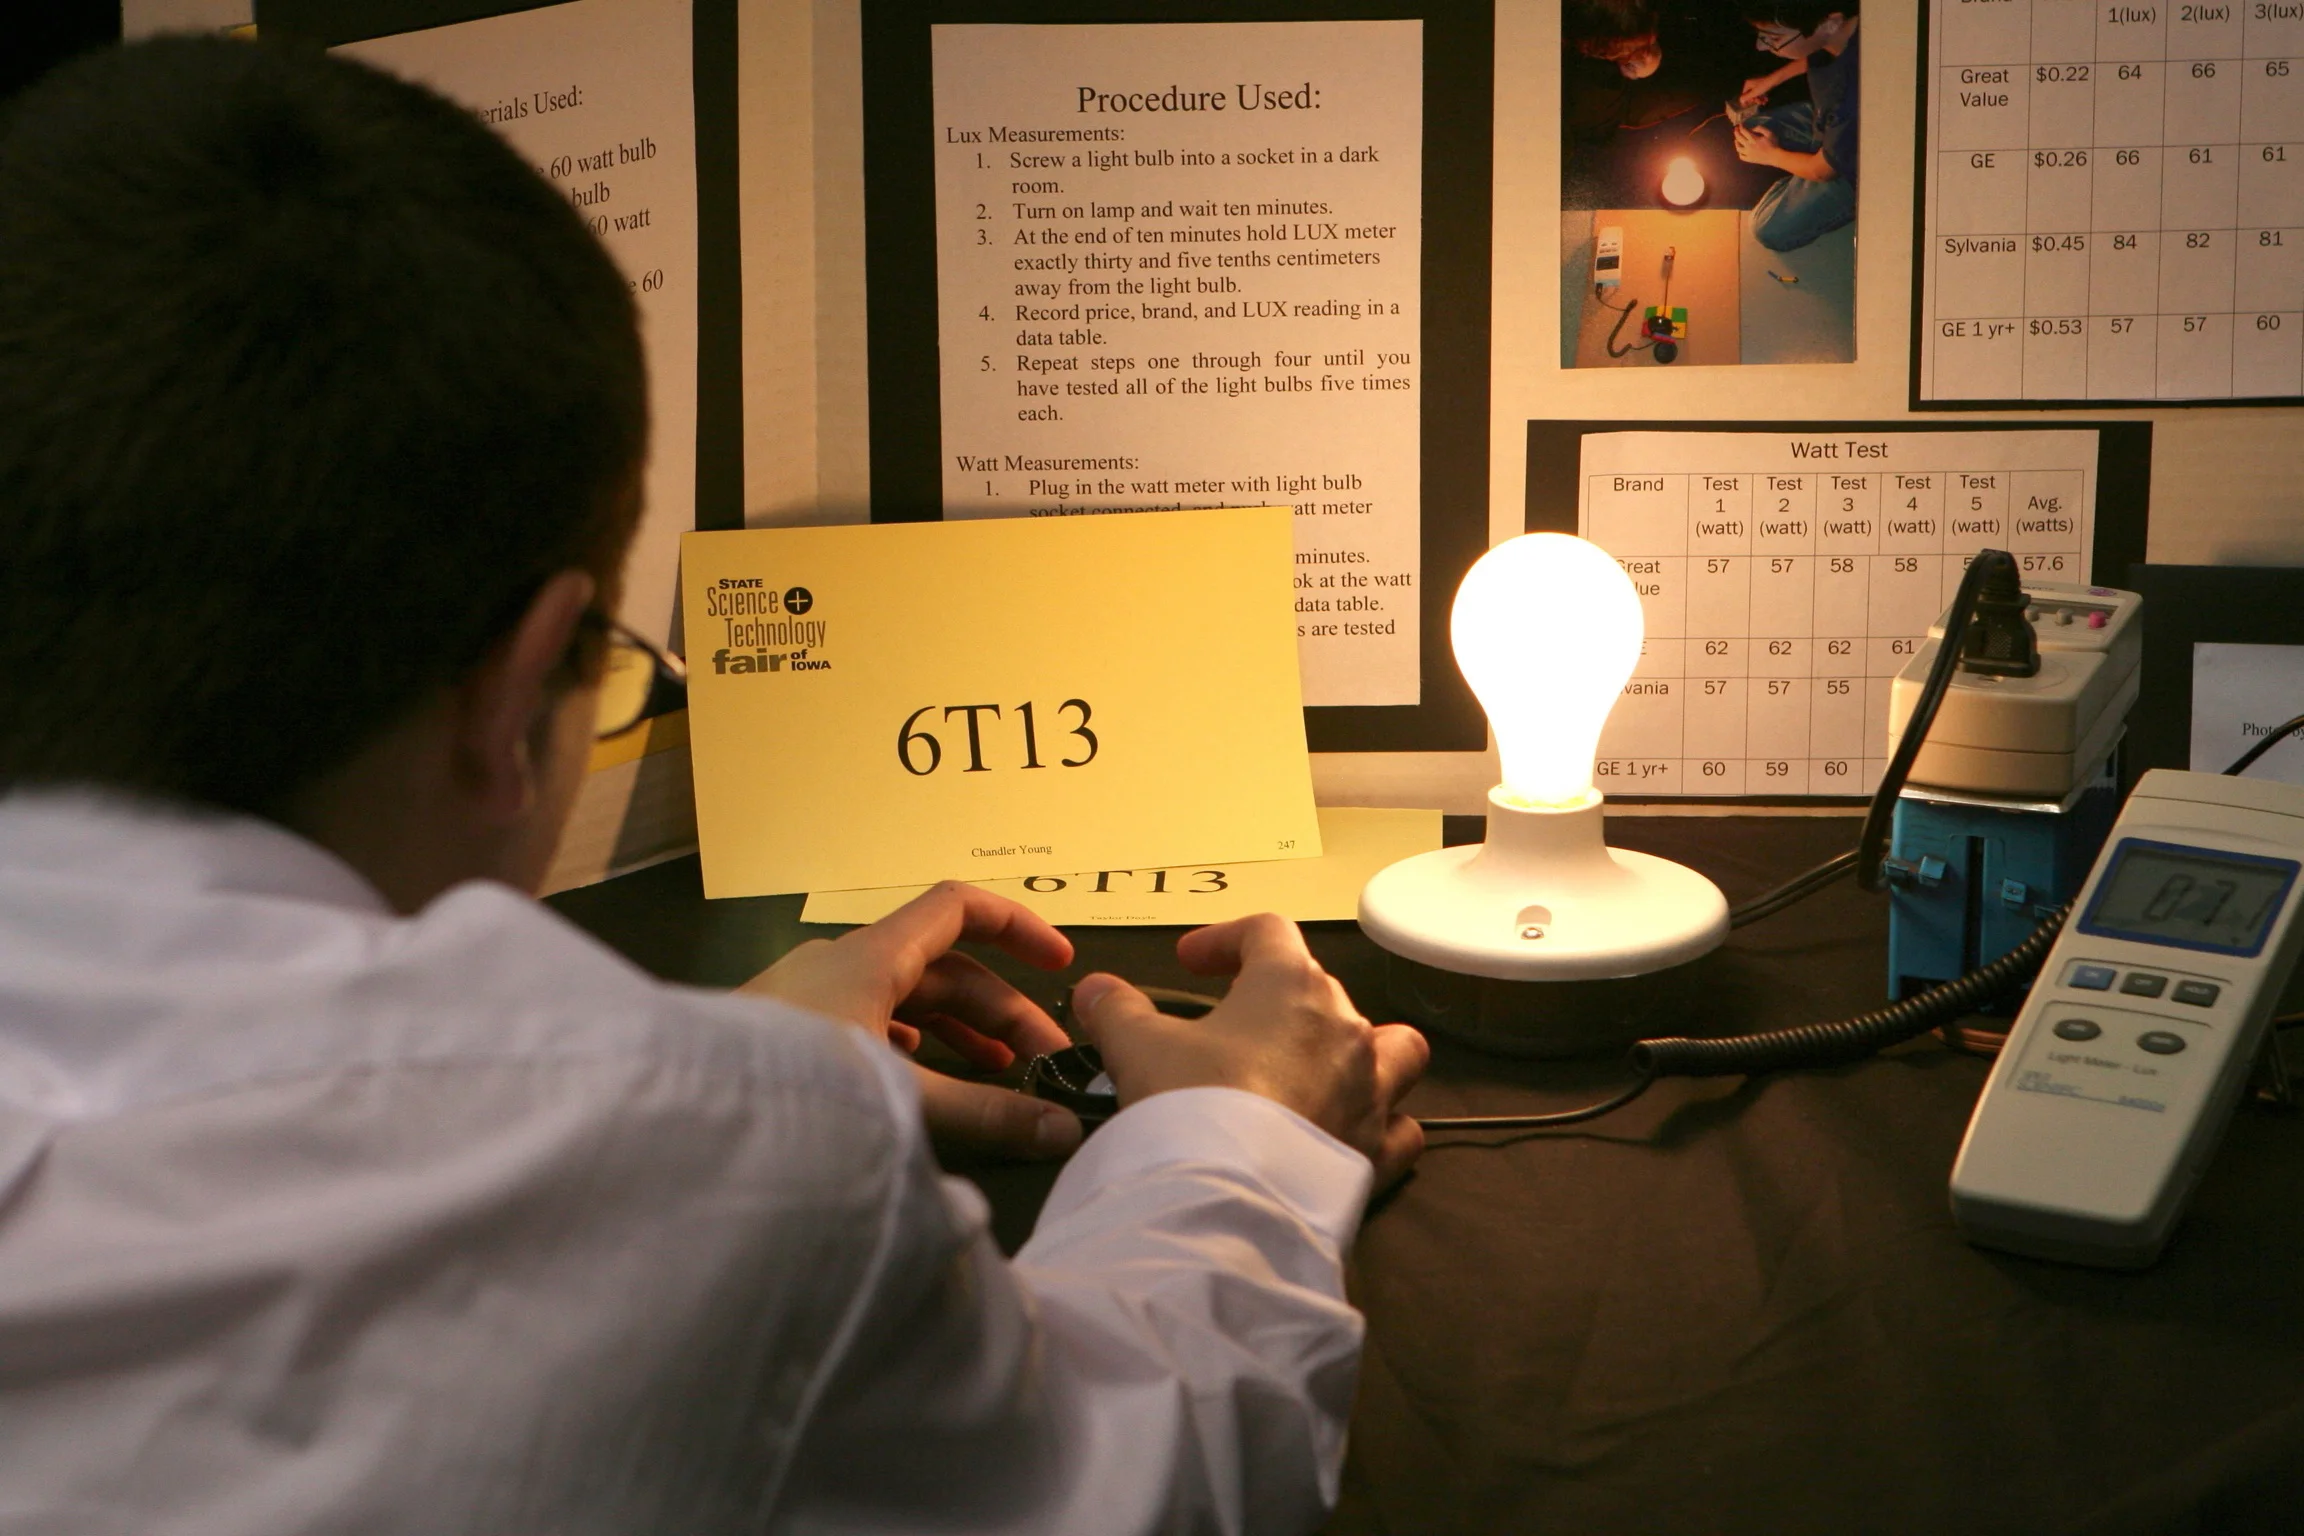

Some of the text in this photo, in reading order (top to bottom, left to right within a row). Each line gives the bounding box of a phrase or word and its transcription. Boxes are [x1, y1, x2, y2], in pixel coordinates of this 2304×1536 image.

[2109, 7, 2156, 25] 1(lux)
[2181, 5, 2229, 23] 2(lux)
[2255, 3, 2303, 21] 3(lux)
[1961, 69, 2008, 84] Great
[2036, 66, 2088, 83] $0.22
[2119, 65, 2141, 80] 64
[2192, 63, 2215, 78] 66
[2266, 61, 2289, 77] 65
[1078, 82, 1320, 112] Procedure Used:
[1960, 92, 2008, 107] Value
[480, 85, 583, 125] erials Used:
[947, 127, 1124, 143] Lux Measurements:
[550, 137, 657, 180] 60 watt bulb
[977, 146, 1379, 171] 1. Screw a light bulb into a socket in a dark
[1971, 154, 1994, 168] GE
[2034, 151, 2087, 168] $0.26
[2116, 150, 2139, 165] 66
[2189, 148, 2212, 163] 61
[2263, 146, 2285, 161] 61
[572, 181, 610, 209] bulb
[614, 209, 651, 232] watt
[977, 224, 1396, 245] 3. At the end of ten minutes hold LUX meter
[2186, 233, 2209, 248] 82
[2260, 231, 2283, 246] 81
[1945, 238, 2016, 256] Sylvania
[2032, 236, 2084, 252] $0.45
[2114, 235, 2136, 250] 84
[642, 269, 664, 292] 60
[2030, 319, 2081, 336] $0.53
[2111, 318, 2133, 333] 57
[2184, 317, 2206, 332] 57
[2257, 315, 2280, 330] 60
[1942, 322, 2014, 339] GE 1 yr+
[981, 350, 1410, 375] 5. Repeat steps one through four until you
[1791, 442, 1888, 458] Watt Test
[956, 456, 1138, 471] Watt Measurements:
[986, 474, 1361, 499] 1. Plug in the watt meter with light bulb
[1614, 478, 1663, 491] Brand
[1703, 477, 1738, 490] Test
[1767, 477, 1802, 490] Test
[1831, 476, 1867, 490] Test
[1895, 476, 1931, 489] Test
[1960, 475, 1995, 489] Test
[1291, 499, 1373, 516] att meter
[1716, 499, 1725, 512] 1
[1779, 498, 1789, 512] 2
[1843, 498, 1853, 512] 3
[1907, 497, 1917, 511] 4
[1971, 497, 1982, 511] 5
[2028, 496, 2062, 513] Avg.
[1696, 521, 1743, 537] (watt)
[1760, 521, 1807, 537] (watt)
[1824, 520, 1871, 537] (watt)
[1888, 520, 1935, 536] (watt)
[1952, 519, 2000, 536] (watt)
[2016, 518, 2073, 535] (watts)
[1296, 548, 1369, 564] minutes.
[2024, 556, 2063, 571] 57.6
[1706, 558, 1729, 573] 57
[1772, 559, 1793, 573] 57
[1831, 558, 1853, 573] 58
[1895, 558, 1917, 572] 58
[719, 579, 763, 589] STATE
[1294, 572, 1411, 588] ok at the watt
[1635, 582, 1661, 596] lue
[707, 587, 778, 616] Science
[1295, 596, 1383, 612] data table.
[725, 616, 826, 648] Technology
[1312, 625, 1337, 636] are
[1344, 619, 1395, 635] tested
[1706, 641, 1728, 655] 62
[1769, 641, 1791, 655] 62
[1828, 640, 1851, 654] 62
[1892, 640, 1914, 654] 61
[712, 648, 807, 674] fair of
[1622, 681, 1669, 695] vania
[1705, 681, 1726, 694] 57
[1768, 681, 1790, 695] 57
[1827, 680, 1849, 694] 55
[898, 698, 1099, 776] 6T13
[1597, 762, 1668, 778] GE 1 yr+
[1703, 762, 1725, 776] 60
[1766, 762, 1788, 776] 59
[1825, 761, 1847, 775] 60
[971, 844, 1053, 858] Chandler Young
[1277, 840, 1296, 851] 247
[1023, 870, 1230, 893] 6T13
